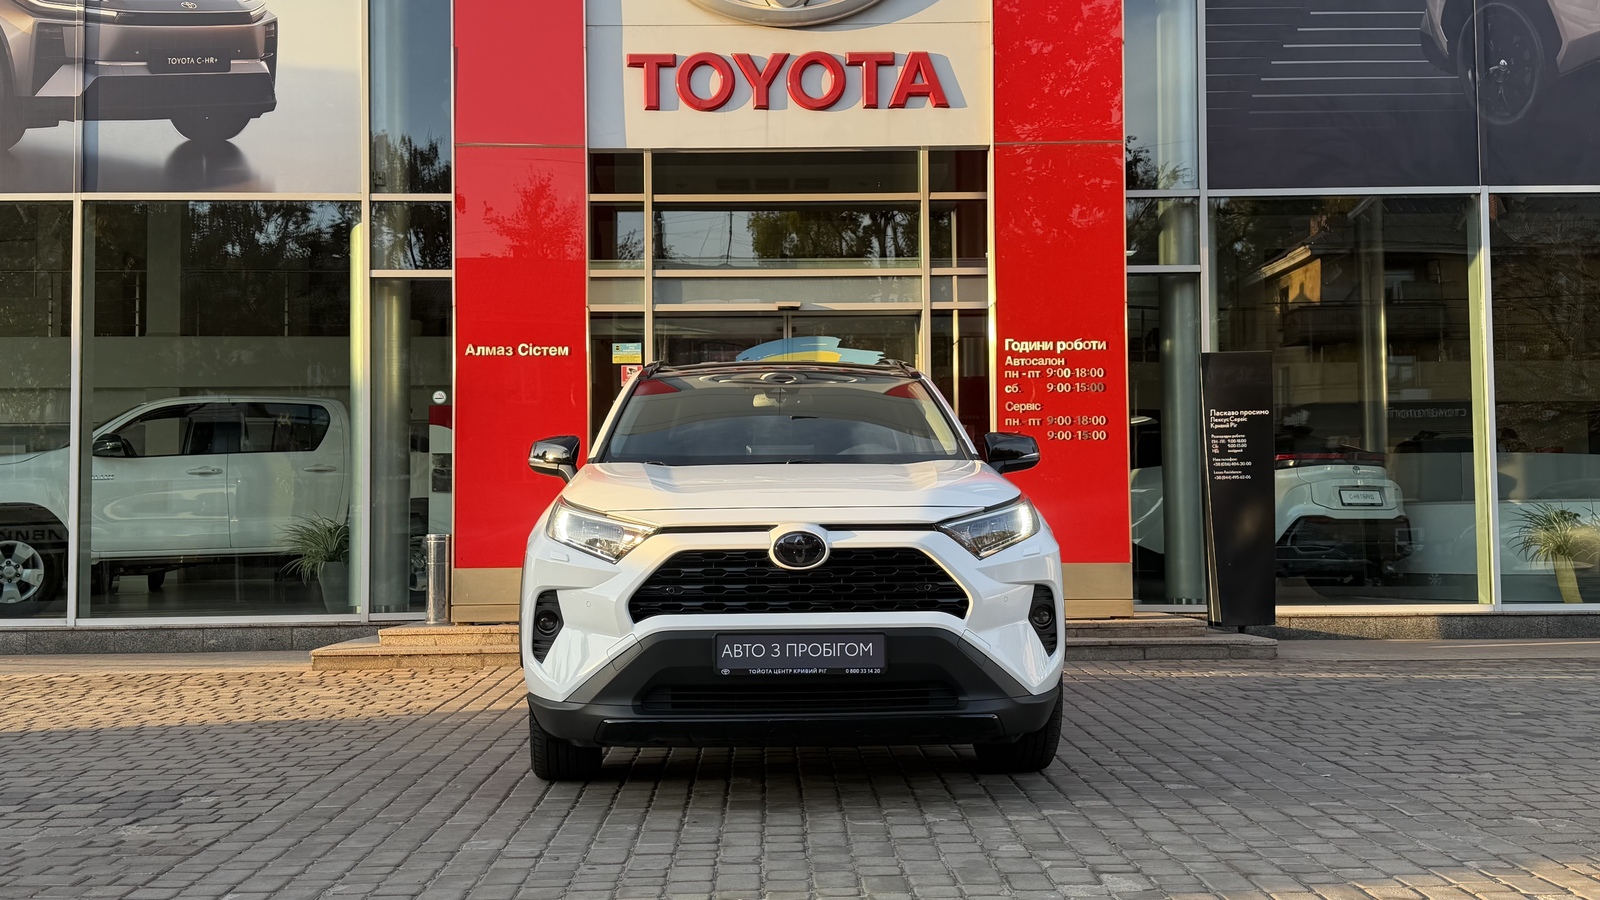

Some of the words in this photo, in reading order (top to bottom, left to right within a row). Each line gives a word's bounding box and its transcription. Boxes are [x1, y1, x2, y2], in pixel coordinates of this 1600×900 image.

[167, 57, 195, 65] TOYOTA
[196, 56, 218, 64] C-HR+
[626, 51, 950, 111] TOYOTA
[464, 343, 514, 356] Алмаз
[517, 343, 569, 356] Сістем
[1004, 338, 1054, 353] Години
[1056, 338, 1107, 354] роботи
[1004, 356, 1066, 367] Автосалон
[1210, 409, 1239, 417] Ласкаво
[1240, 409, 1270, 417] просимо
[721, 643, 766, 658] АВТО
[770, 643, 781, 658] З
[786, 642, 873, 657] ПРОБІГОМ
